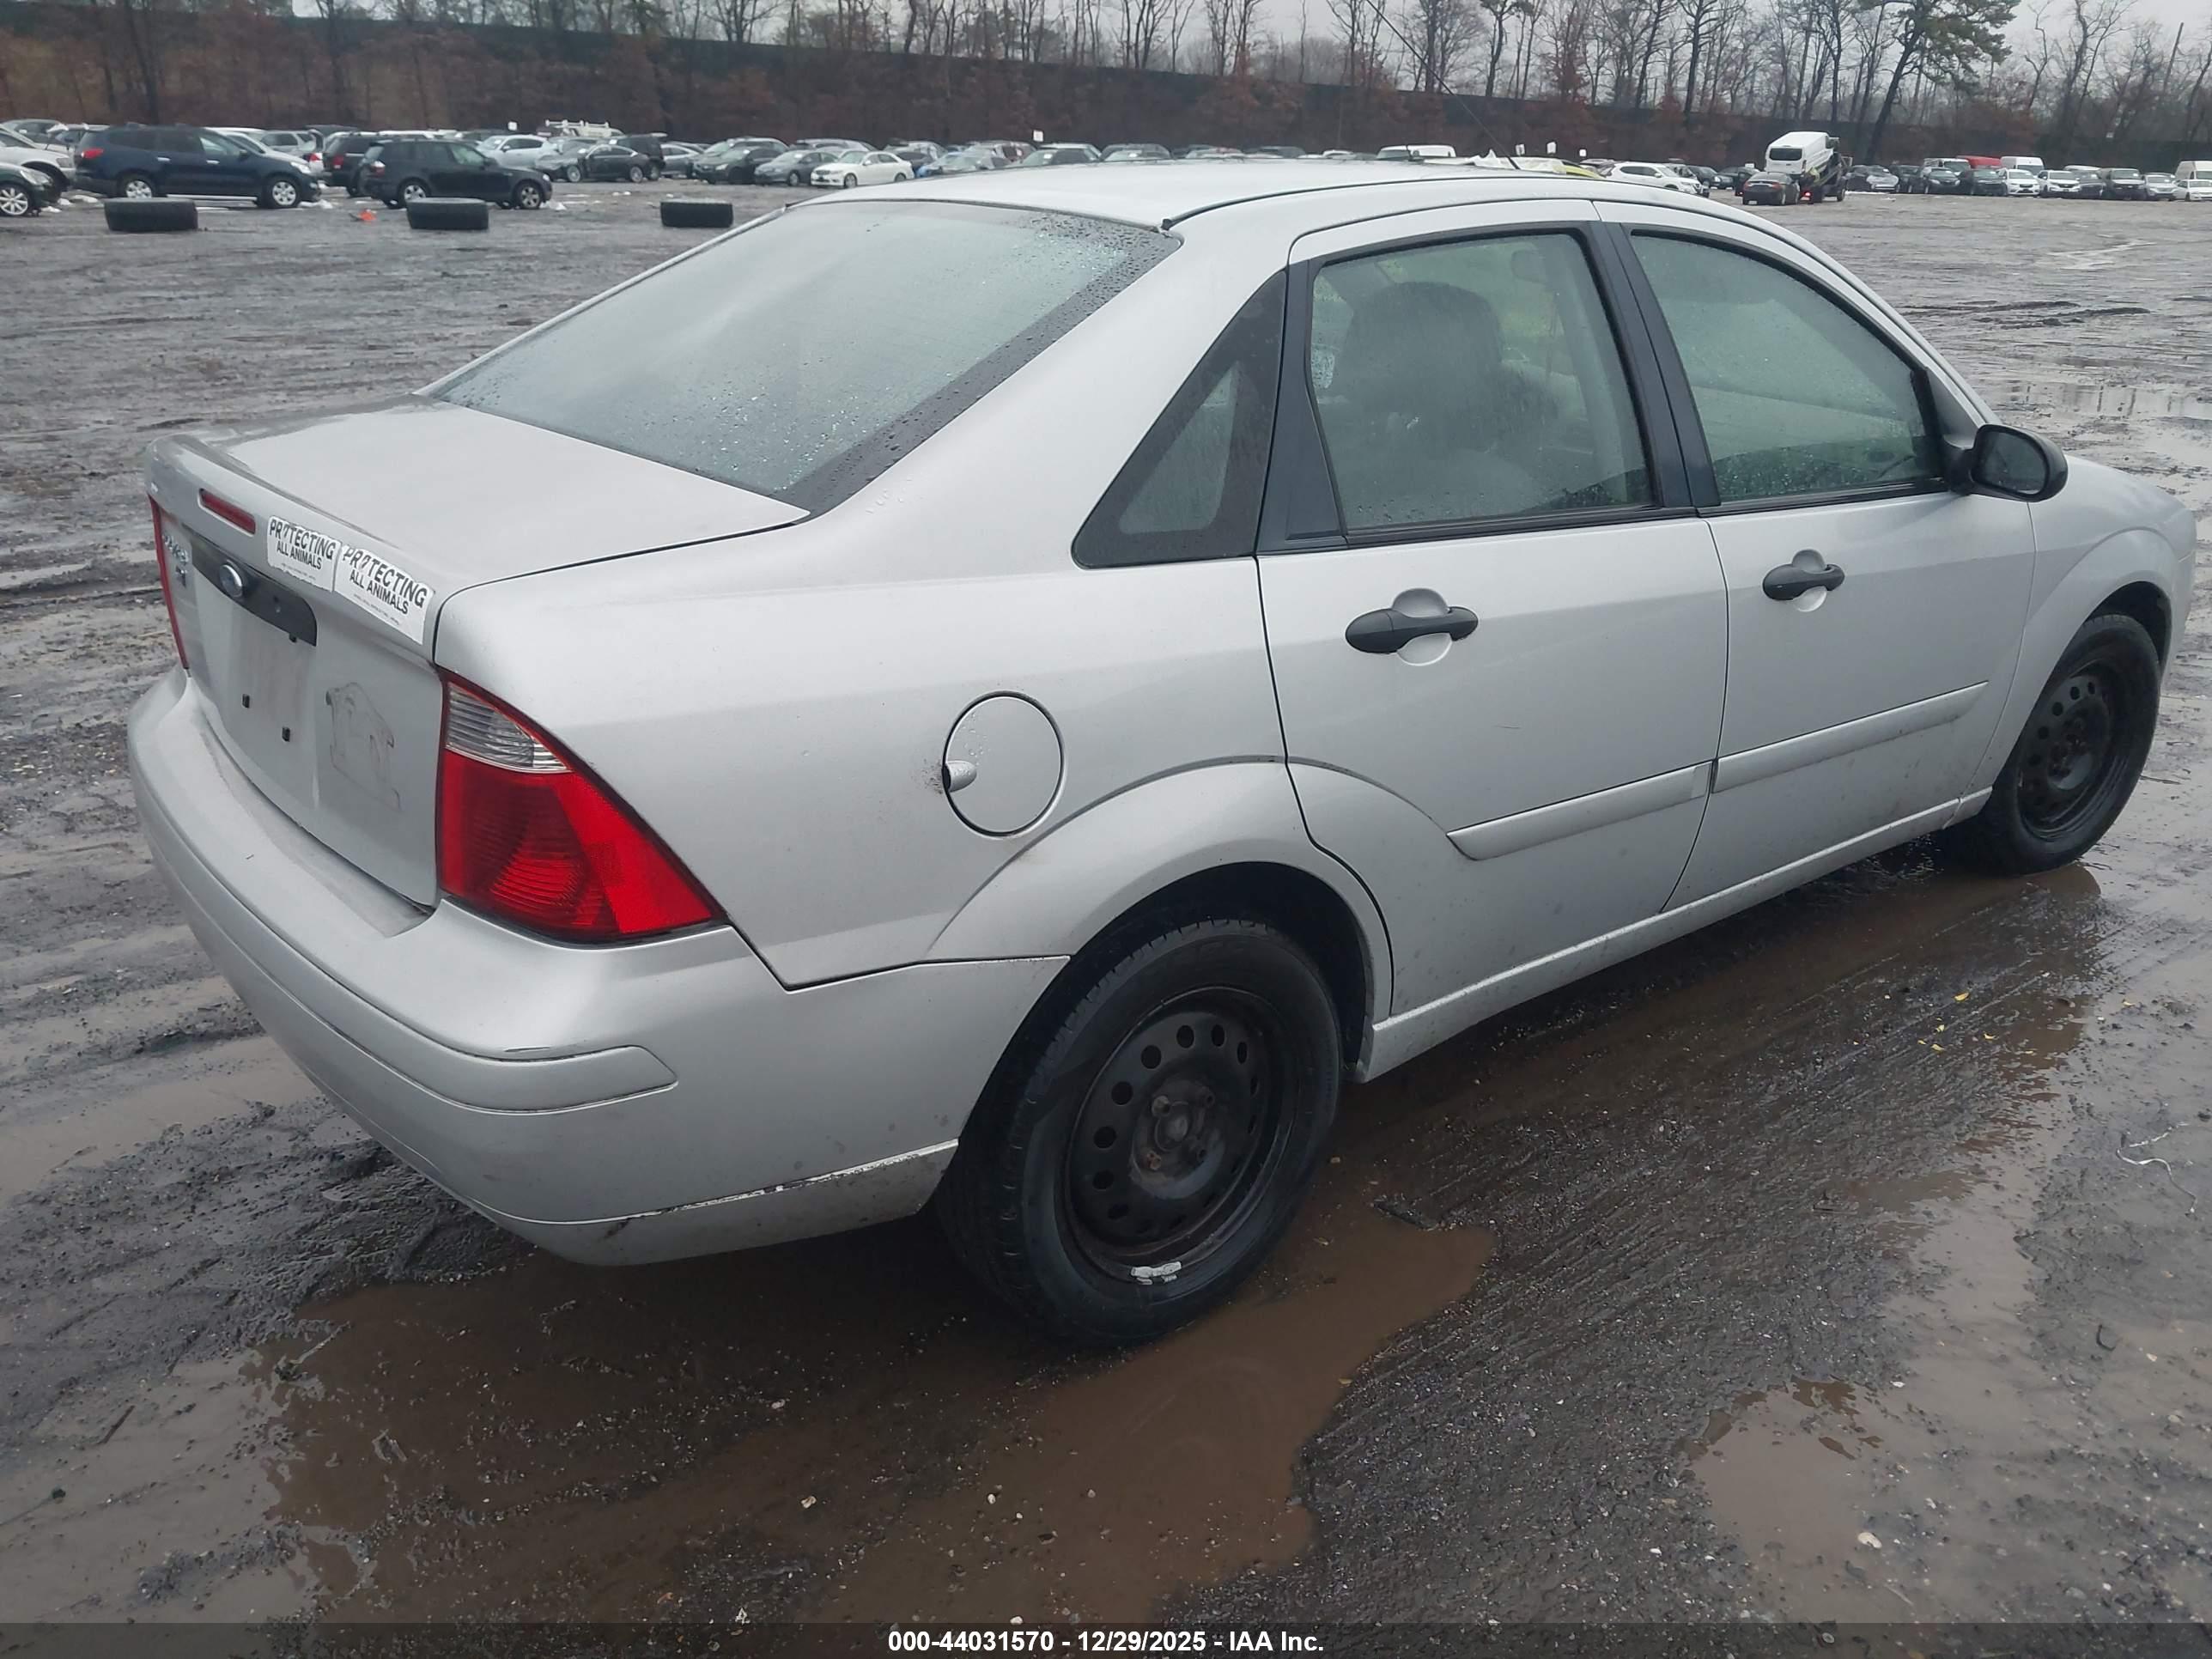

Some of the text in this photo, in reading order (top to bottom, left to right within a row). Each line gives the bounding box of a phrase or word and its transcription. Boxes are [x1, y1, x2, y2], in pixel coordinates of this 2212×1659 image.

[276, 540, 322, 569] ALL ANIMALS
[349, 569, 364, 589] ALL
[367, 580, 409, 614] ANIMALS
